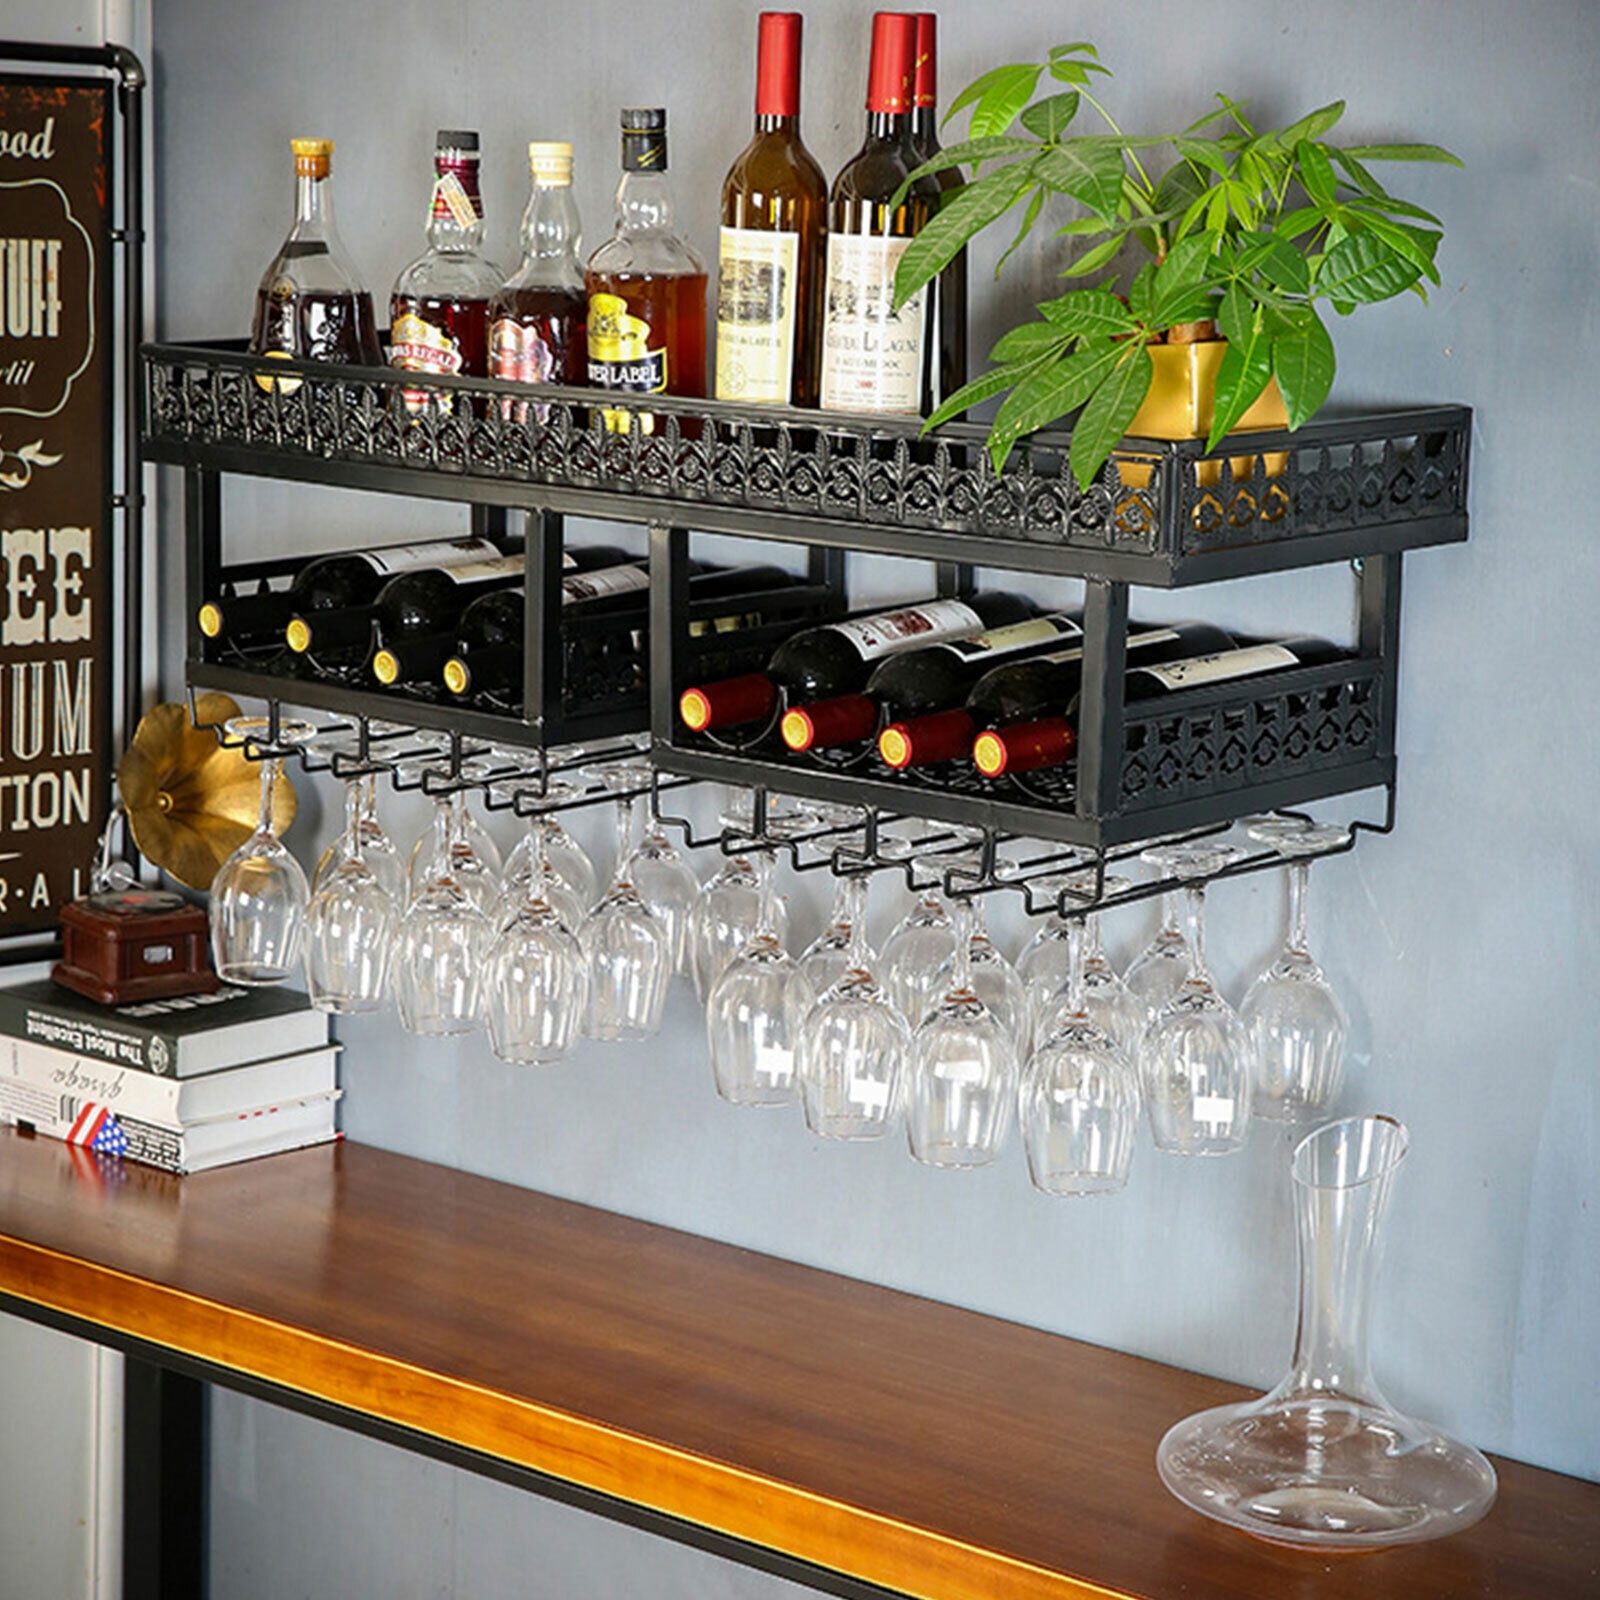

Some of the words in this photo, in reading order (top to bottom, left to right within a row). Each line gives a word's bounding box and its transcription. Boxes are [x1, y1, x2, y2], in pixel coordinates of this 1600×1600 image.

[610, 364, 661, 384] LABEL
[2, 528, 91, 646] EE
[0, 657, 93, 762] UM
[27, 1018, 84, 1050] Excellent
[85, 1032, 118, 1059] Most
[119, 1041, 144, 1065] The
